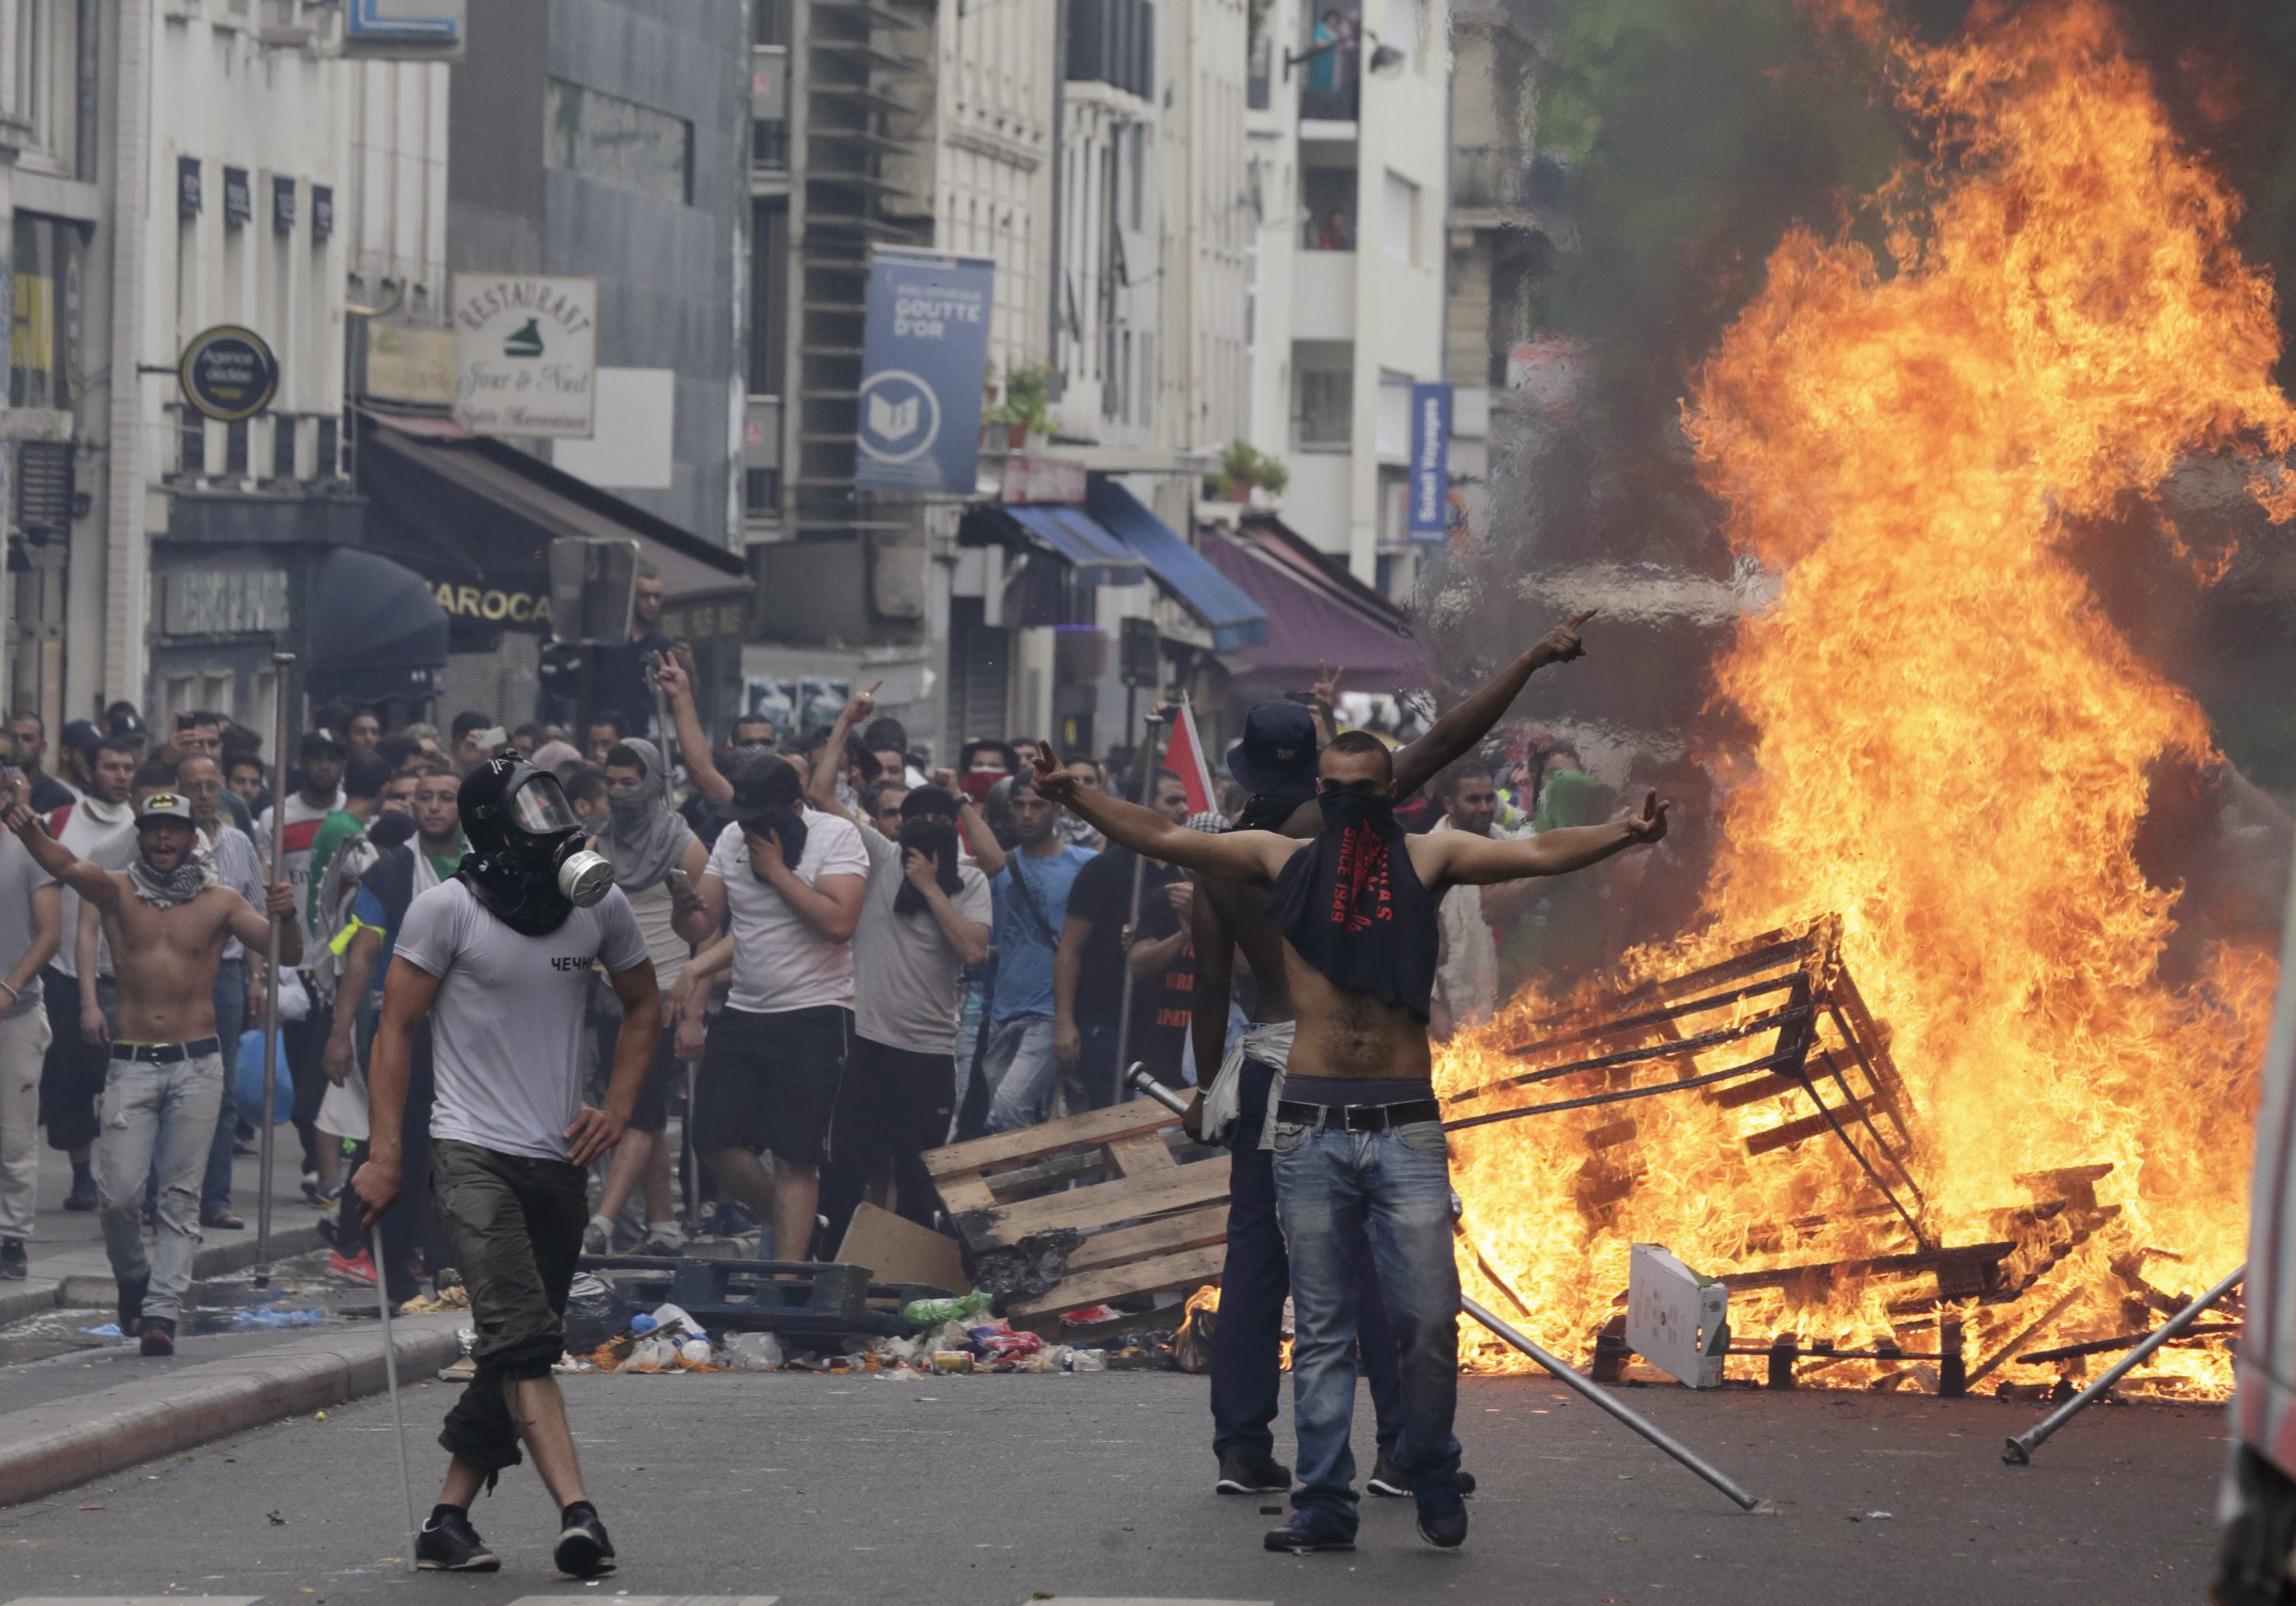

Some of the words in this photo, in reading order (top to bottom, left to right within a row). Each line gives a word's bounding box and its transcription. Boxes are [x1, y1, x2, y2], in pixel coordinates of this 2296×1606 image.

[458, 281, 590, 336] RESTAURANT
[894, 298, 981, 322] GOUTTE
[893, 319, 944, 340] D'OR
[1420, 397, 1441, 472] Voyages
[426, 581, 554, 622] AROCA
[1338, 826, 1356, 876] SINCE
[1331, 882, 1348, 922] 1949
[551, 956, 595, 971] ЧЕЧН
